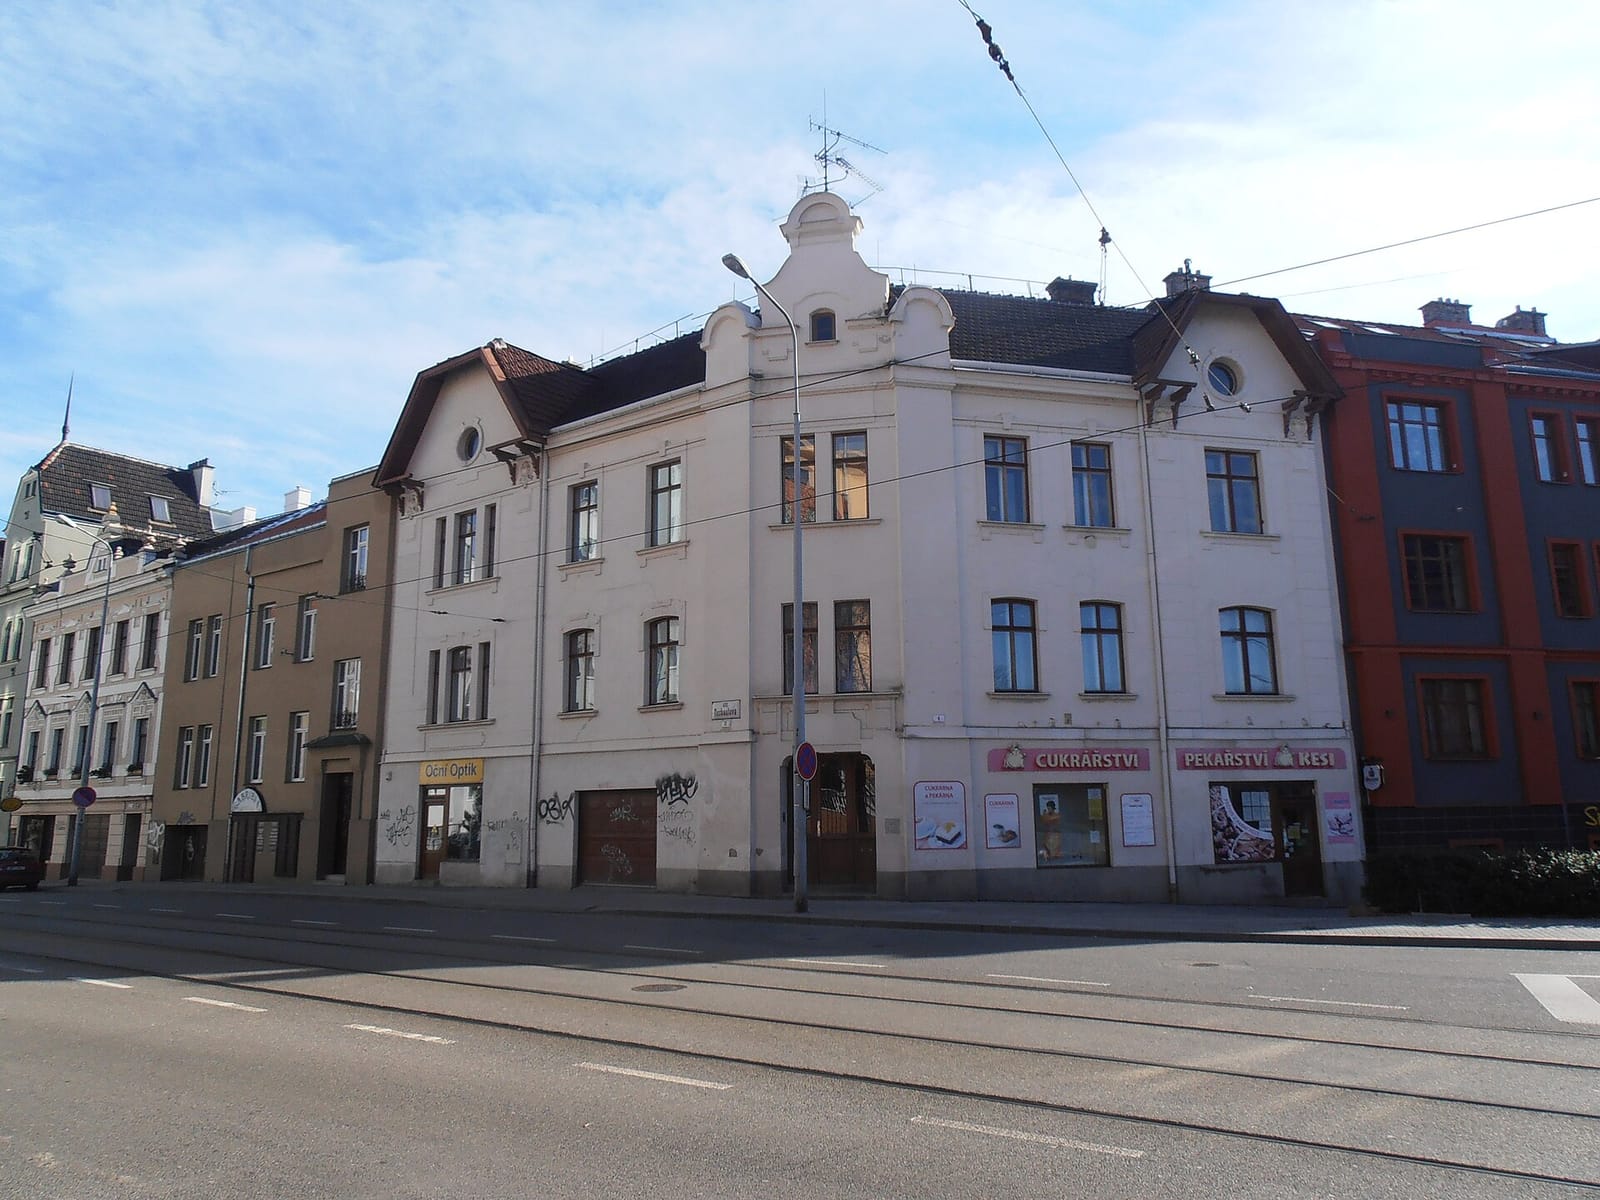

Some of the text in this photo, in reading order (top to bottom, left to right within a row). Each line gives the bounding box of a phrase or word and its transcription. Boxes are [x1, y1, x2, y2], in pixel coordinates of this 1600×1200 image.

[1185, 749, 1335, 767] PEKAŘSTVÍ KESI
[425, 763, 477, 779] Oční Optik
